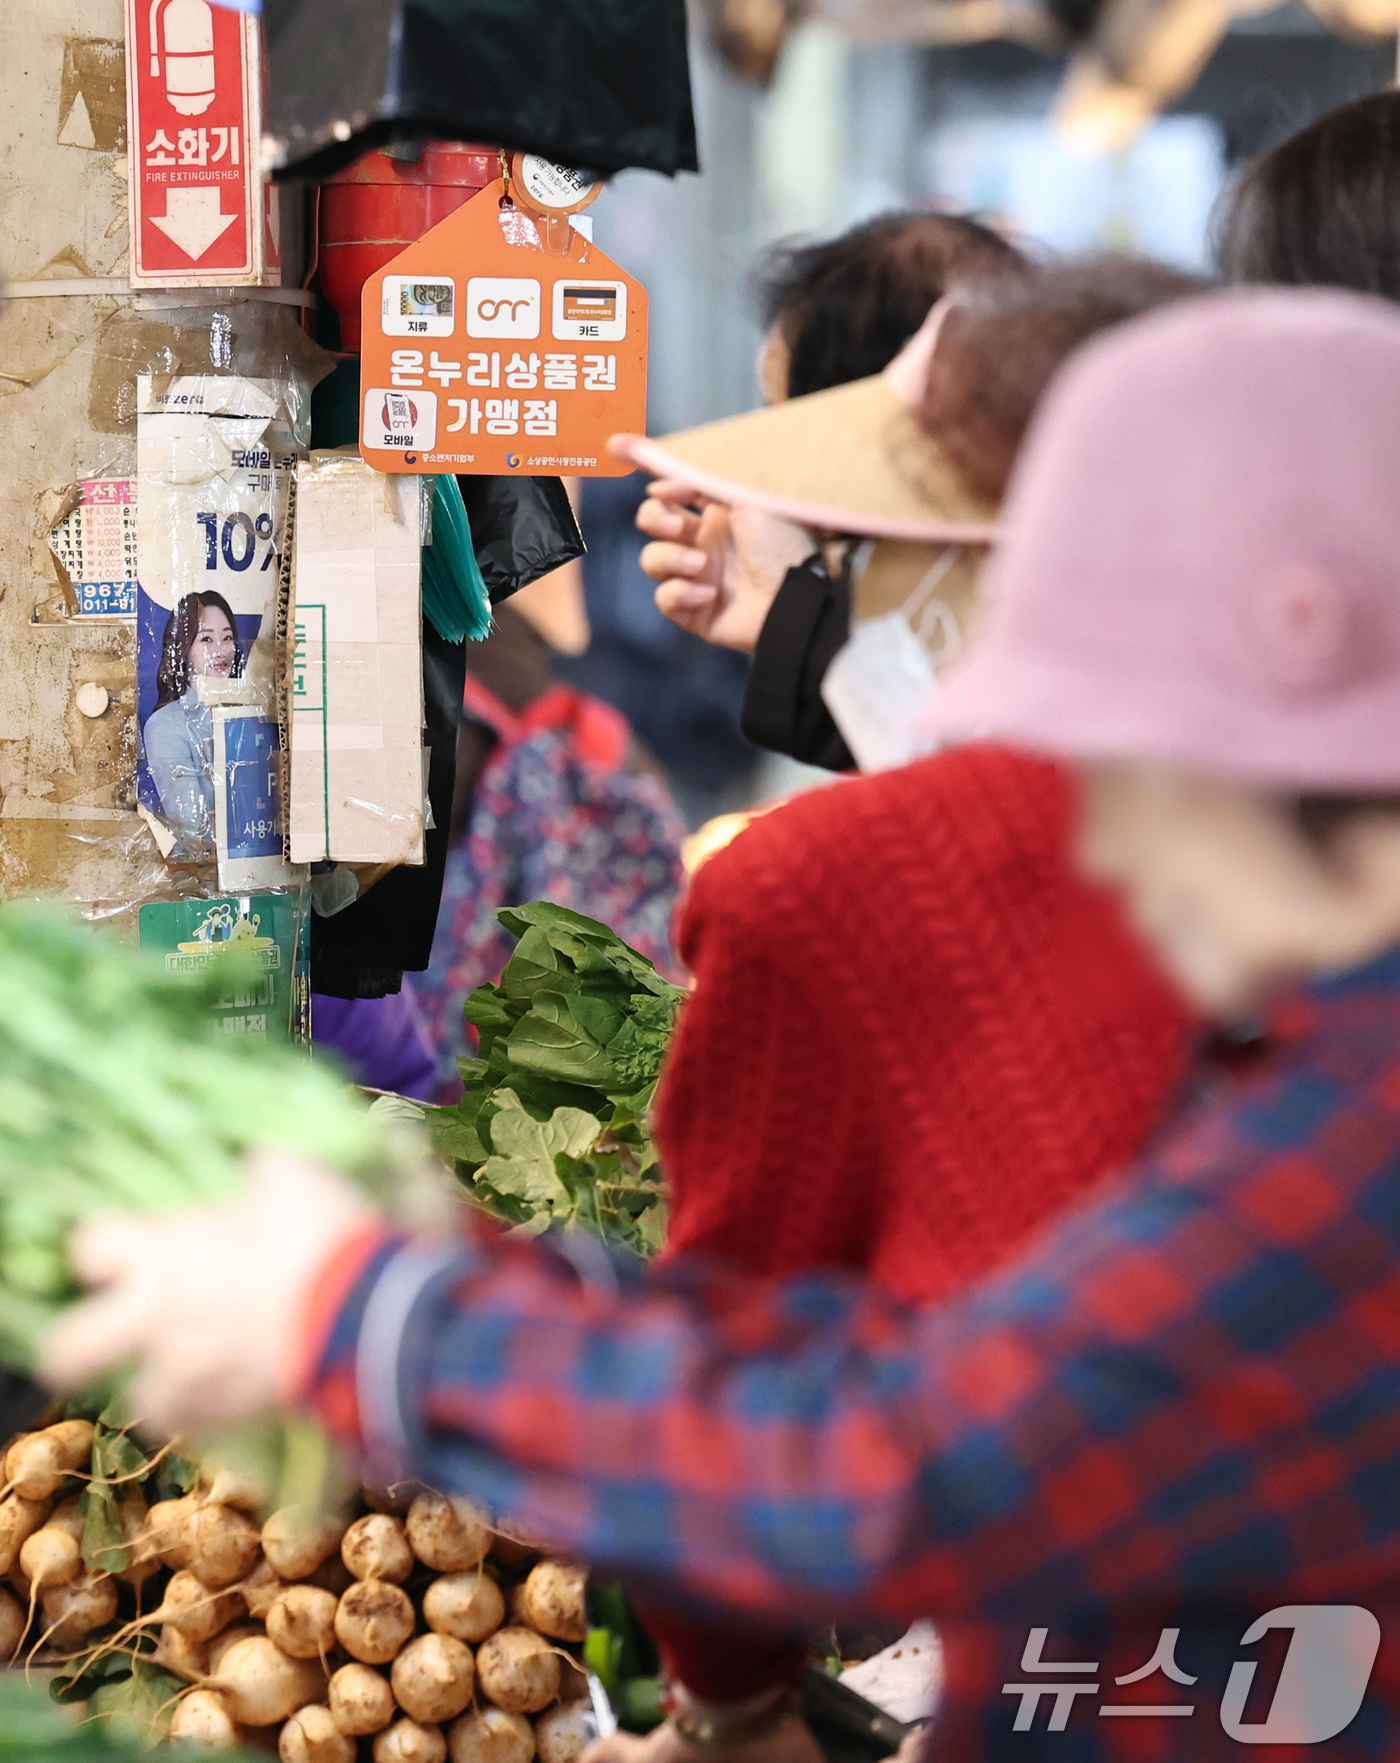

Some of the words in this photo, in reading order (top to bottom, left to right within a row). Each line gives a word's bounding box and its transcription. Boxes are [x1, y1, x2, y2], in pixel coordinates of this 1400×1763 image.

[145, 126, 240, 167] 소화기
[146, 172, 168, 182] FIRE
[170, 170, 240, 182] EXTINGUISHER
[407, 321, 428, 332] 지류
[579, 325, 599, 337] 카드
[389, 349, 617, 392] 온누리상품권
[446, 397, 558, 437] 가맹점
[383, 434, 414, 446] 모바일
[421, 453, 475, 464] 중소벤처기업부
[526, 455, 598, 467] 소상공인시장진흥공단
